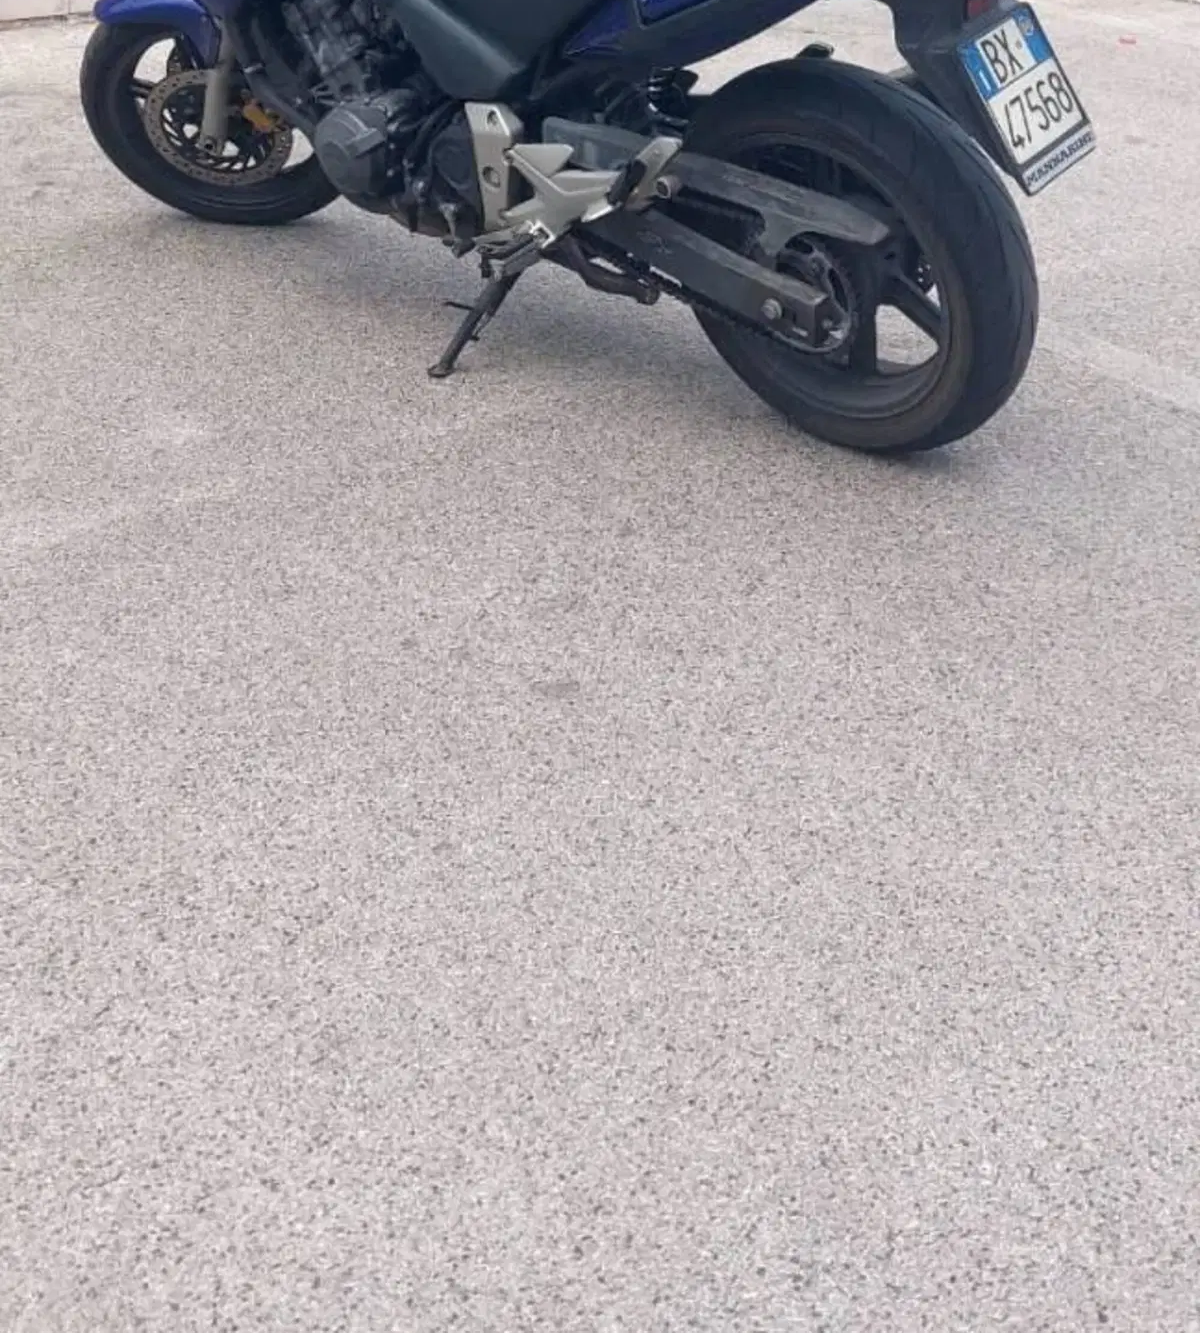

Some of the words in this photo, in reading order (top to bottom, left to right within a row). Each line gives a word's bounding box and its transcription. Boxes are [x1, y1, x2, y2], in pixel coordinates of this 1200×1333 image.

[978, 71, 992, 91] I
[980, 29, 1023, 84] BX
[1004, 72, 1073, 149] 47568
